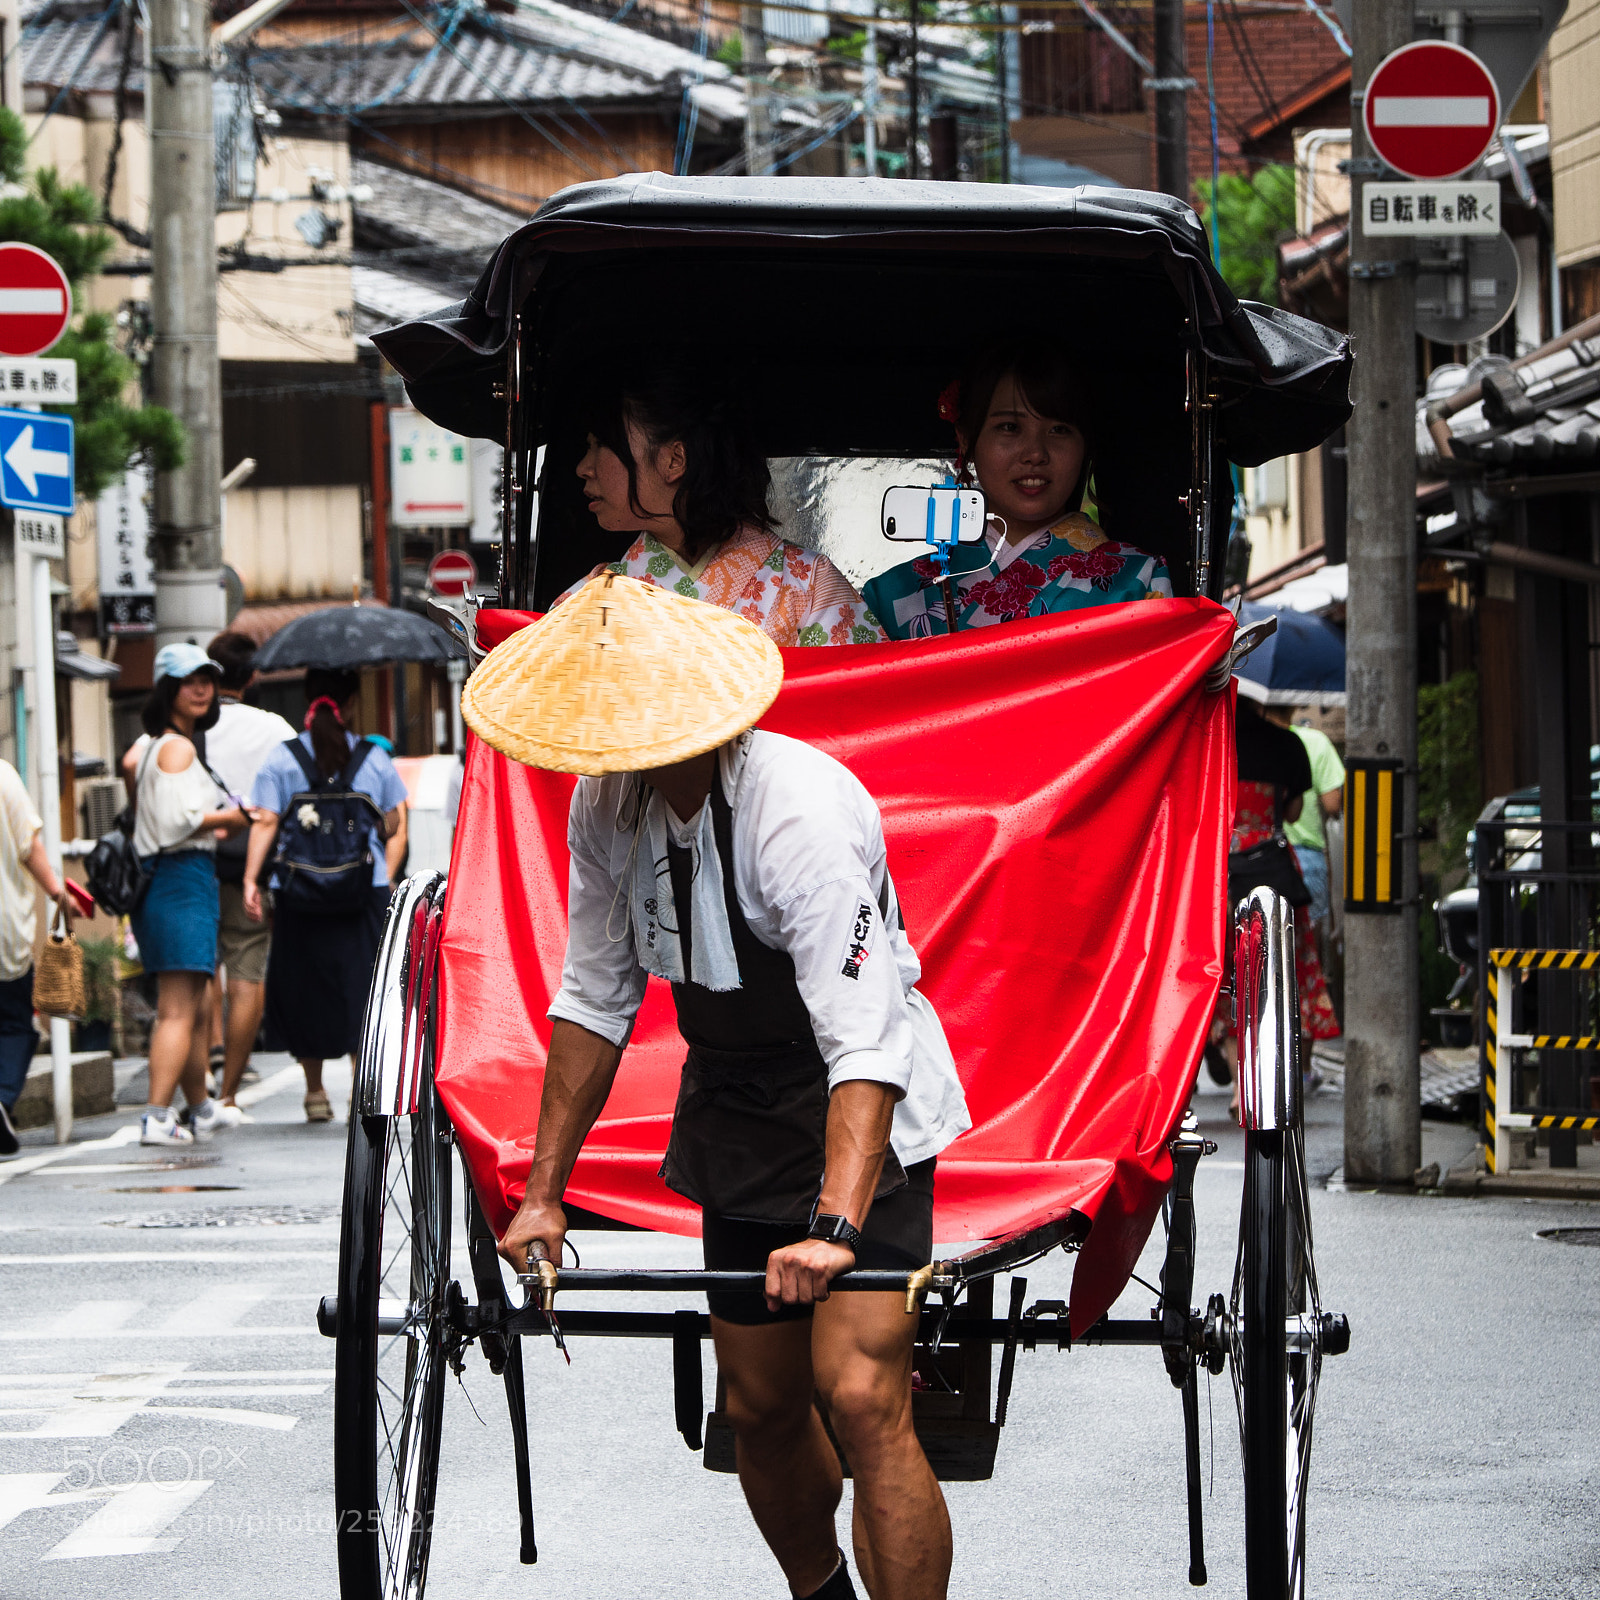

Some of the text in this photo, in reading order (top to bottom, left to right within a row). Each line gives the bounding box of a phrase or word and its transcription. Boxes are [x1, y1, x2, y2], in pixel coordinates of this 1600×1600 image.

[1370, 195, 1494, 223] 自転車を除く
